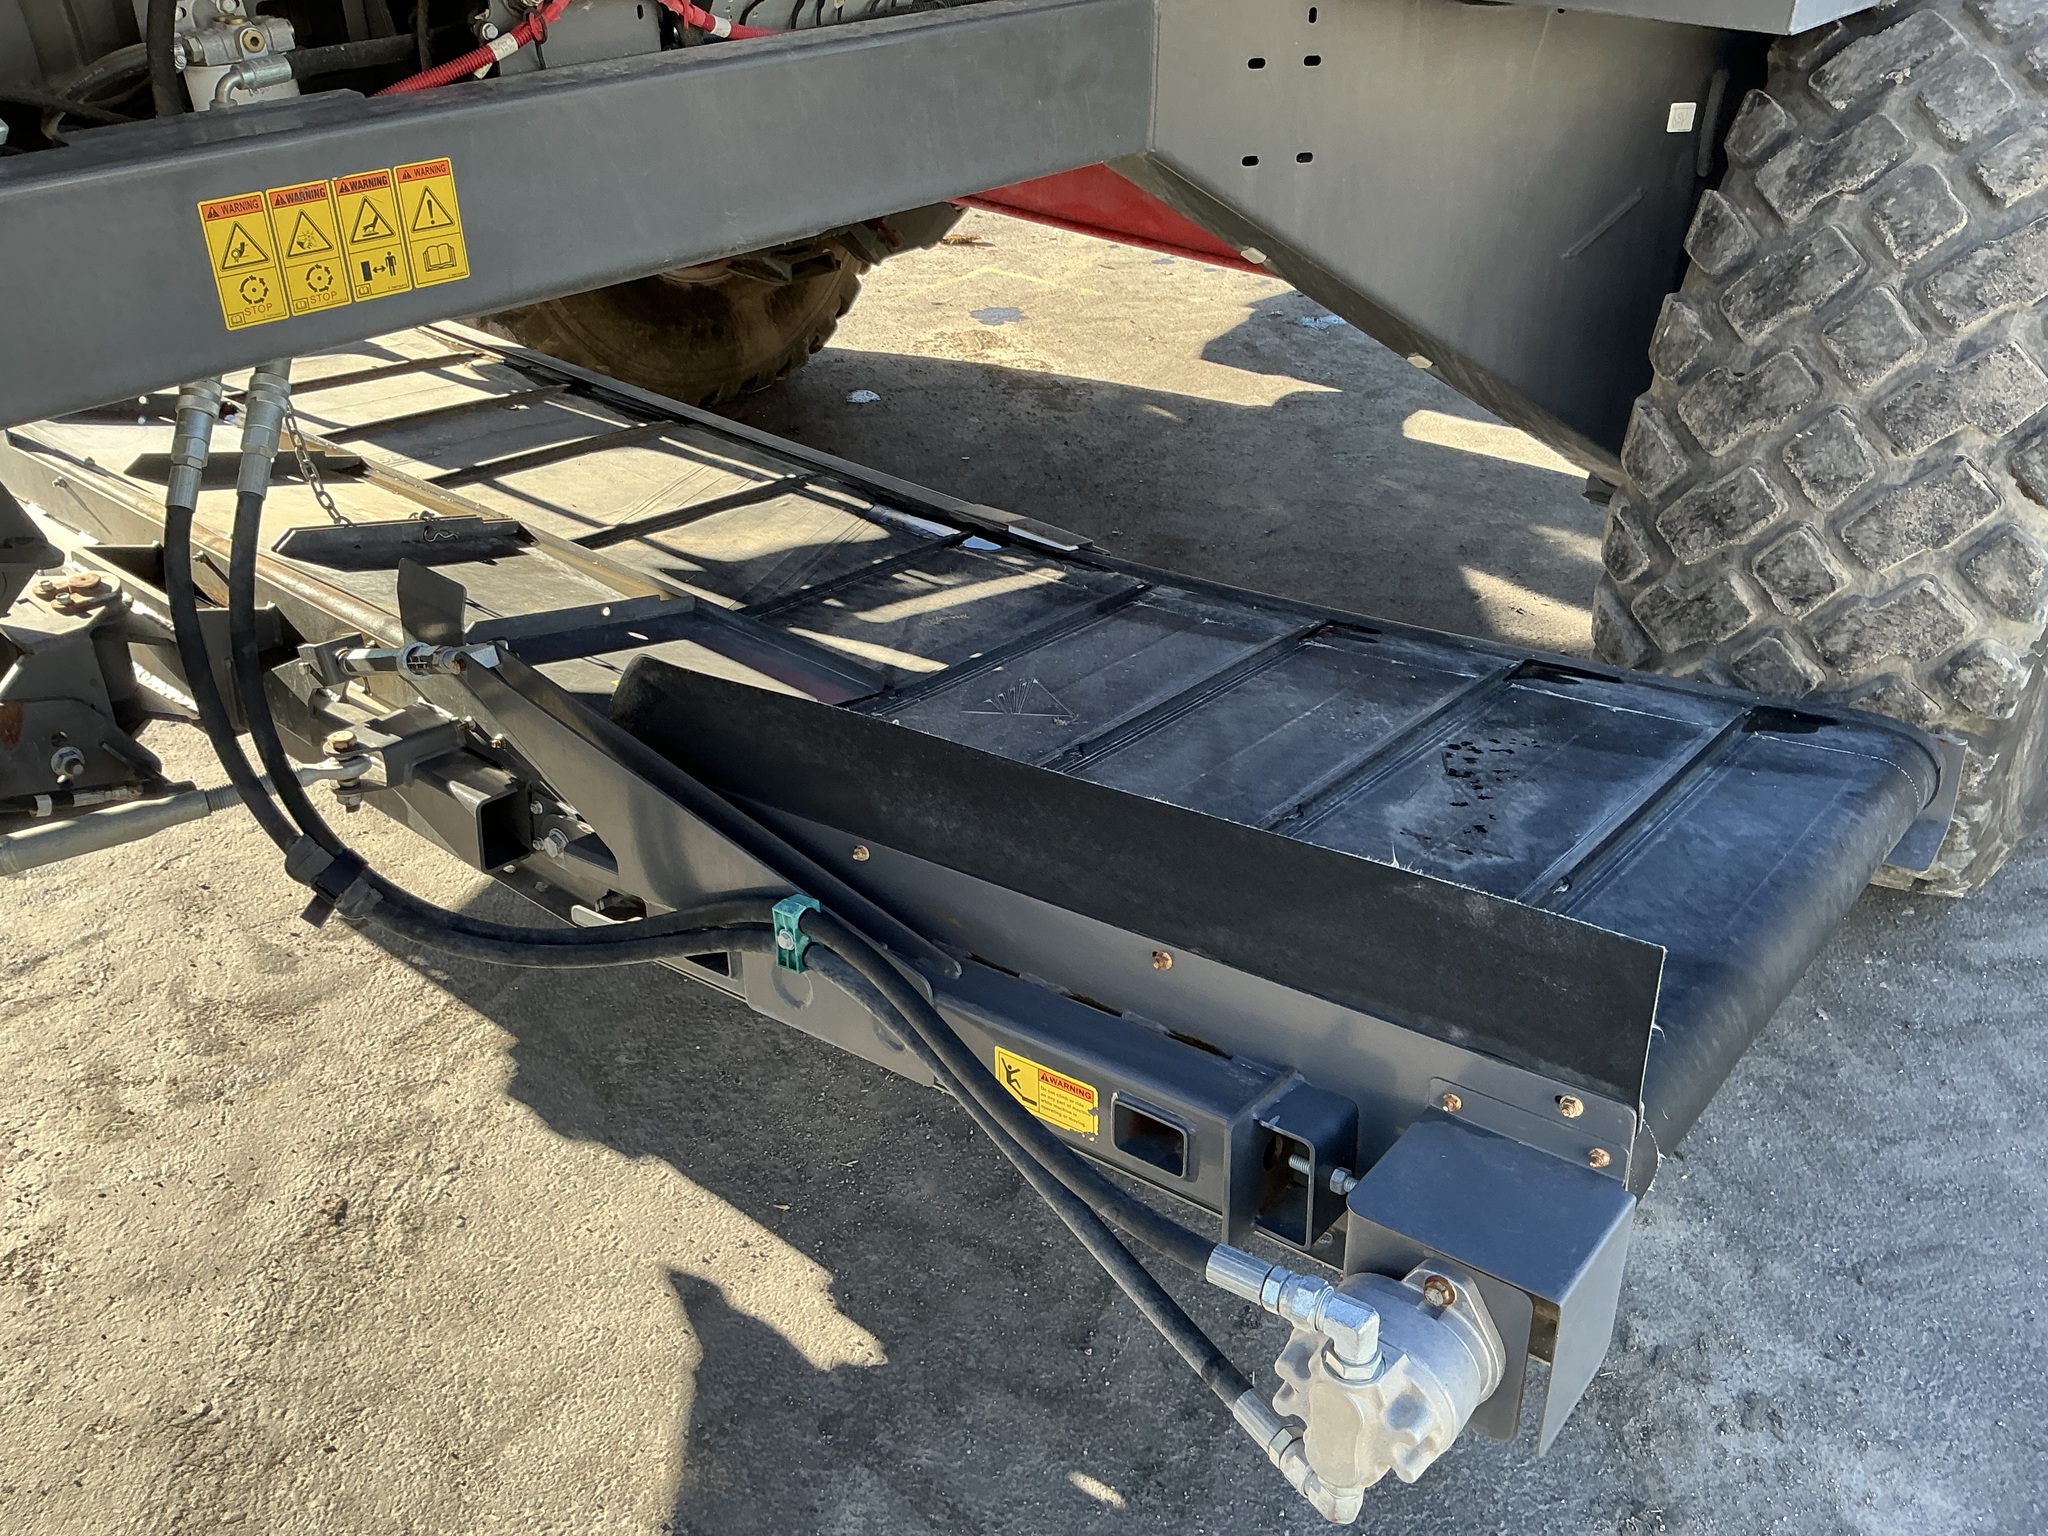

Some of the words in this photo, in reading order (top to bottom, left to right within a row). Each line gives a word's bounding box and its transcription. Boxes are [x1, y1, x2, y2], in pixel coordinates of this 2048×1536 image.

[413, 164, 447, 177] WARNING
[349, 175, 388, 190] WARNING
[286, 187, 326, 204] WARNING
[220, 199, 259, 215] WARNING
[309, 291, 338, 305] STOP
[244, 302, 273, 317] STOP
[1050, 1076, 1091, 1099] WARNING
[1054, 1104, 1072, 1115] machine
